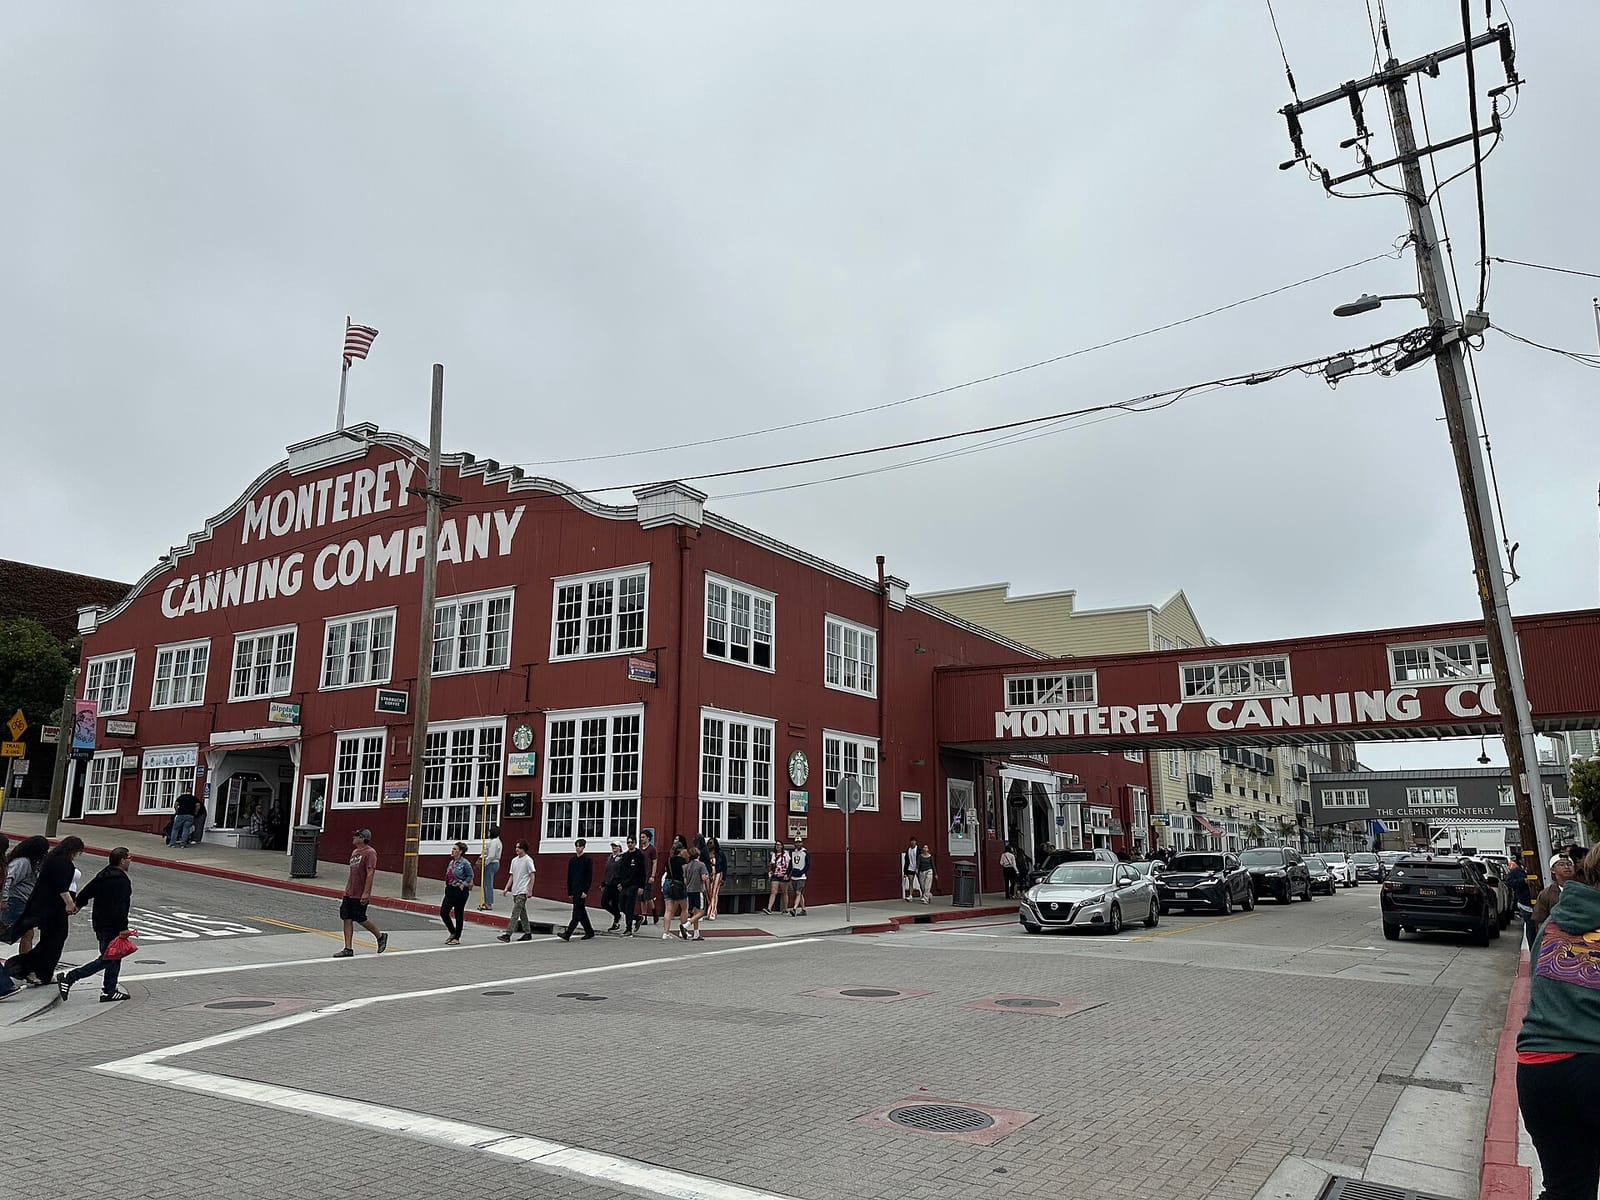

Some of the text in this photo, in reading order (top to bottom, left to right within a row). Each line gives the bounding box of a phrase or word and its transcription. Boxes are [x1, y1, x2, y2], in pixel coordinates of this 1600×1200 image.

[241, 456, 419, 545] MONTEREY
[160, 505, 526, 619] CANNING COMPANY
[253, 732, 261, 740] 711
[994, 703, 1184, 738] MONTEREY
[1206, 688, 1421, 732] CANNING
[1376, 807, 1495, 816] THE CLEMENT MONTEREY
